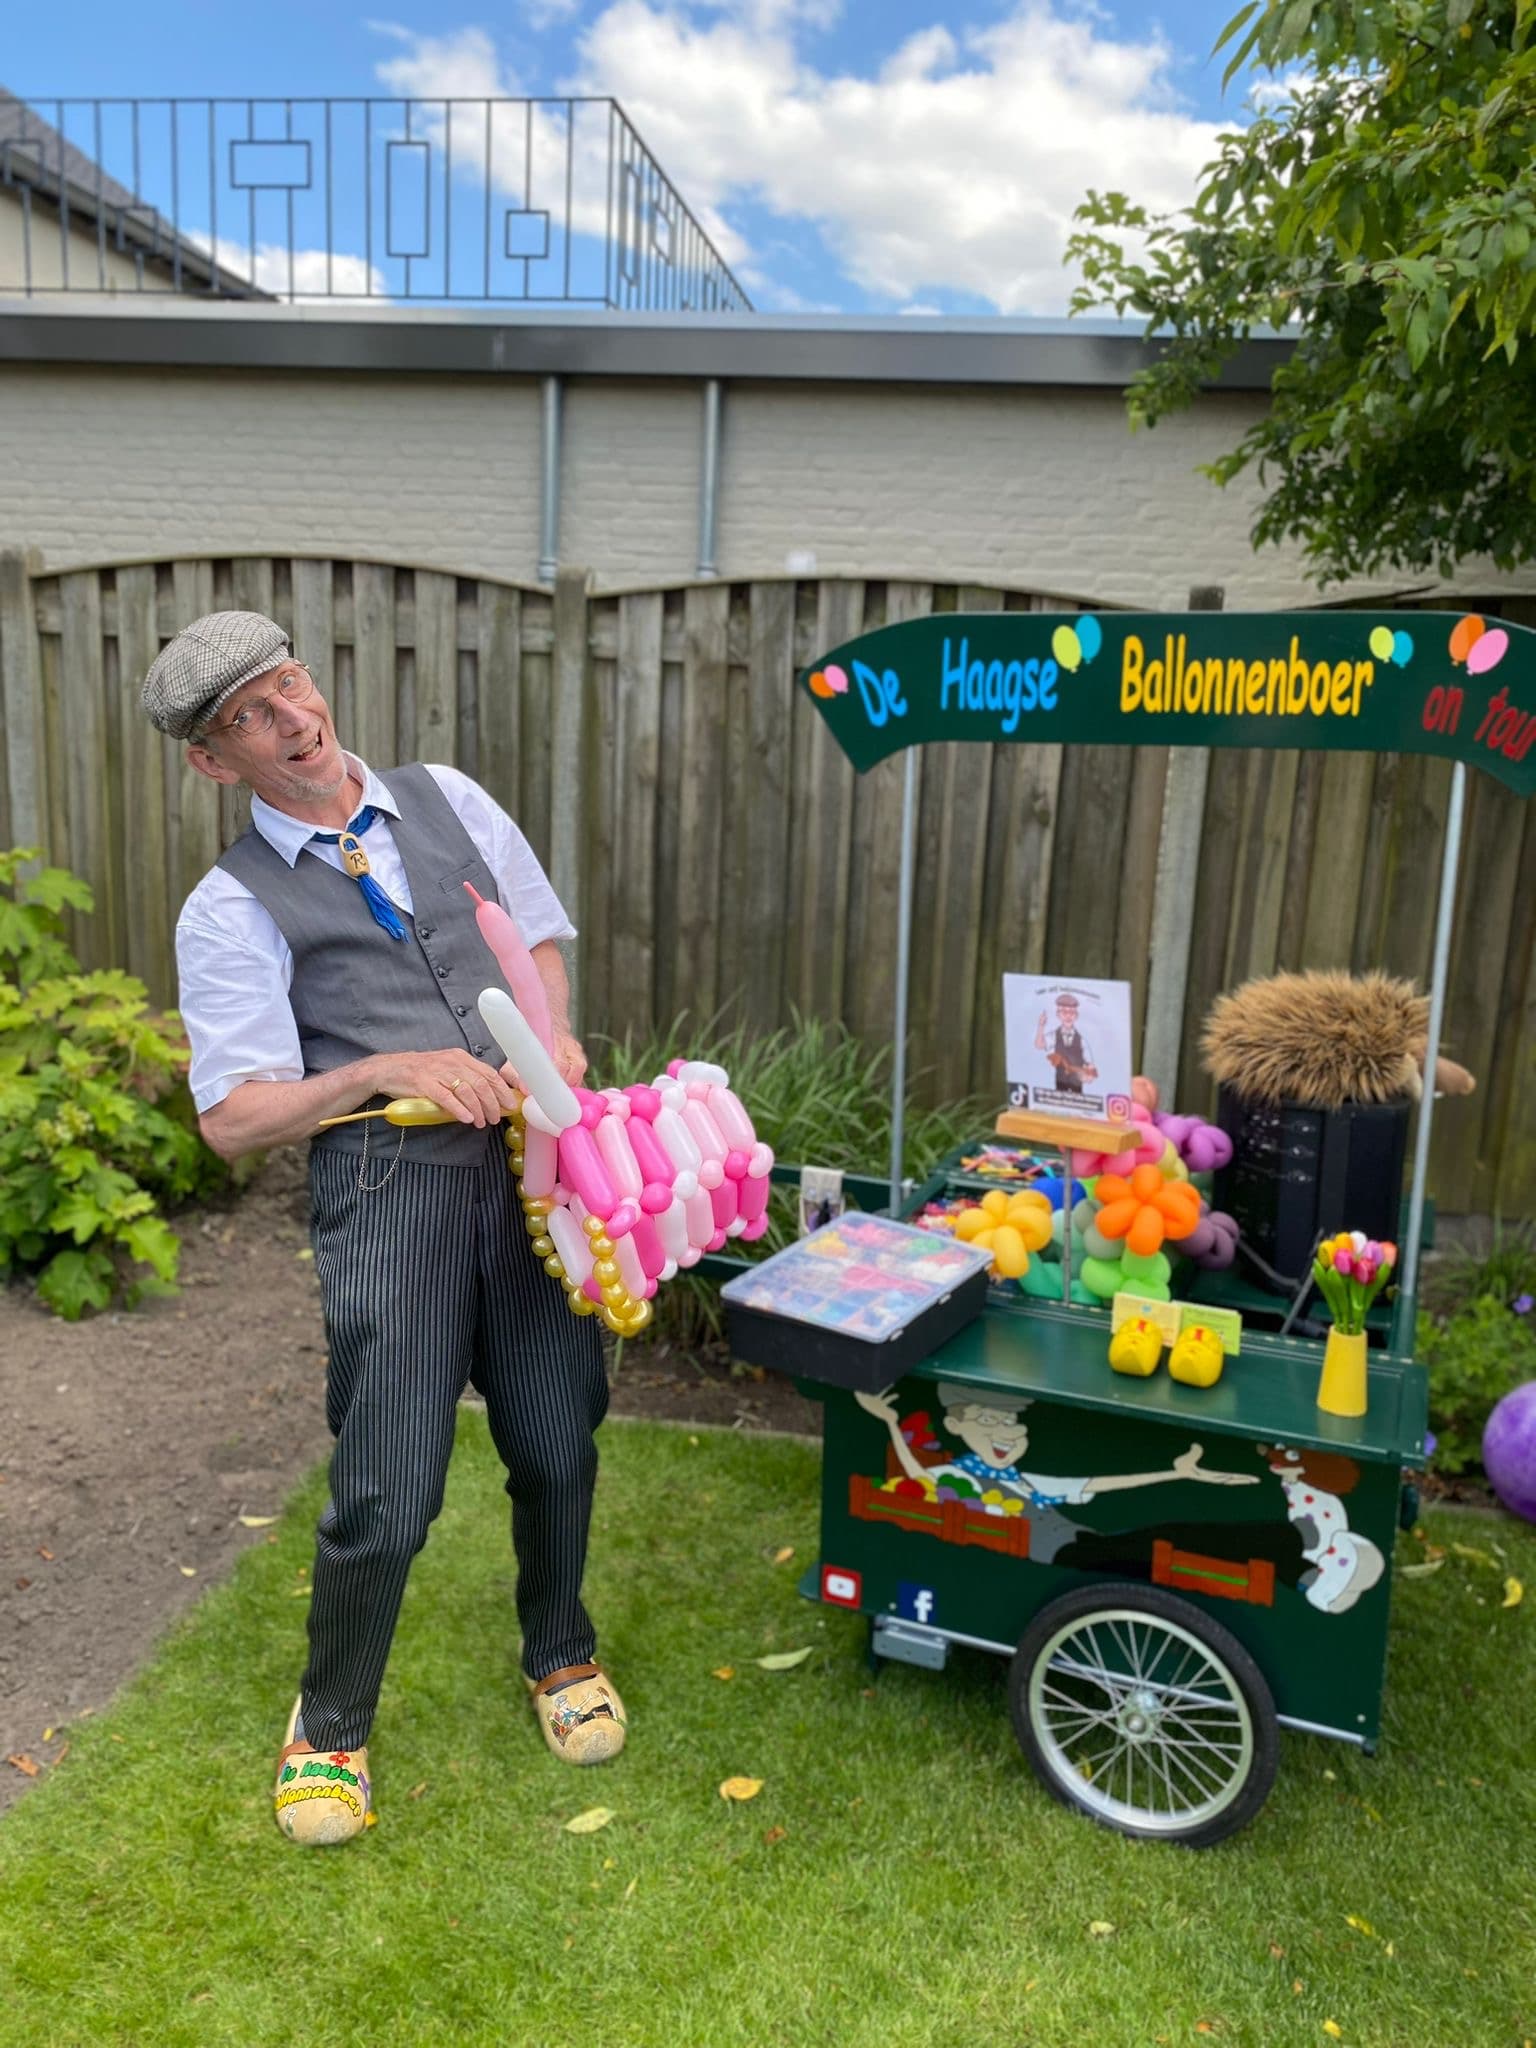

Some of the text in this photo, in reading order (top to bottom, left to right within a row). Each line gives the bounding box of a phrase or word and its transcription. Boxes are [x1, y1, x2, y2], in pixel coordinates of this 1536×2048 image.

[851, 659, 908, 727] De
[940, 637, 1058, 733] Haagse
[1120, 634, 1374, 716] Ballonnenboer
[1423, 685, 1463, 736] on
[350, 853, 367, 869] R
